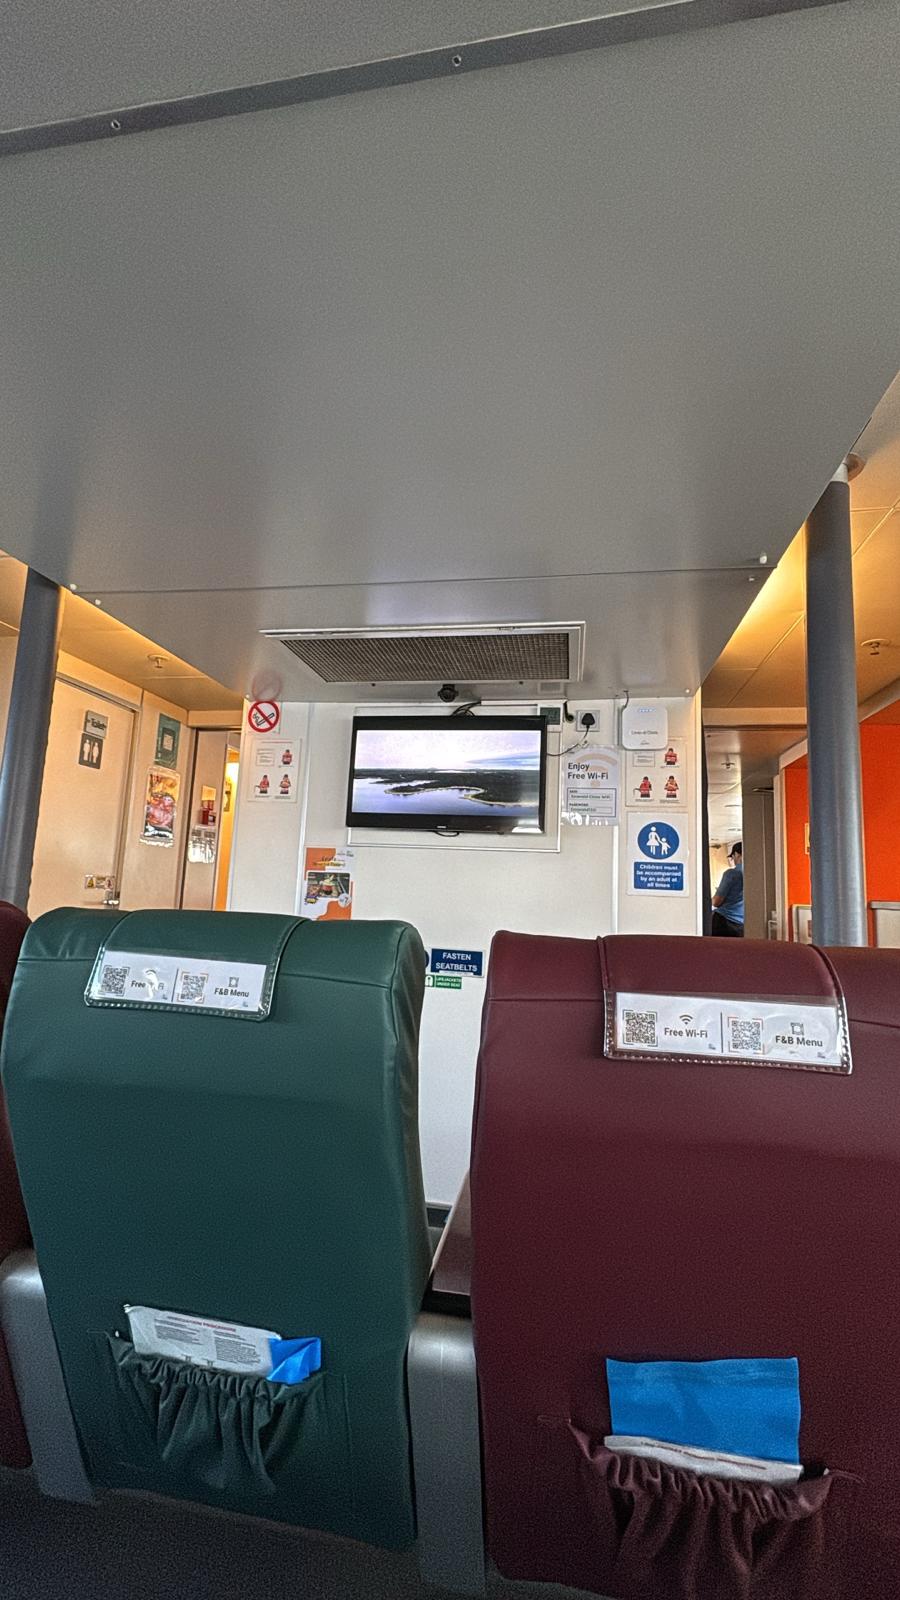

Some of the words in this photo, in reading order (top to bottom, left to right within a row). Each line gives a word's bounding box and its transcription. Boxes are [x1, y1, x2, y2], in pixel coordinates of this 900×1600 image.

[91, 718, 107, 731] Toilet
[568, 762, 590, 771] Enjoy
[567, 772, 586, 780] Free
[587, 772, 609, 780] Wi-Fi
[442, 952, 471, 961] FASTEN
[435, 962, 478, 972] SEATBELTS
[130, 979, 146, 988] Free
[213, 987, 229, 996] F&B
[229, 988, 250, 998] Menu
[664, 1027, 684, 1037] Free
[685, 1028, 708, 1039] Wi-Fi
[775, 1035, 794, 1045] F&B
[796, 1036, 823, 1047] Menu
